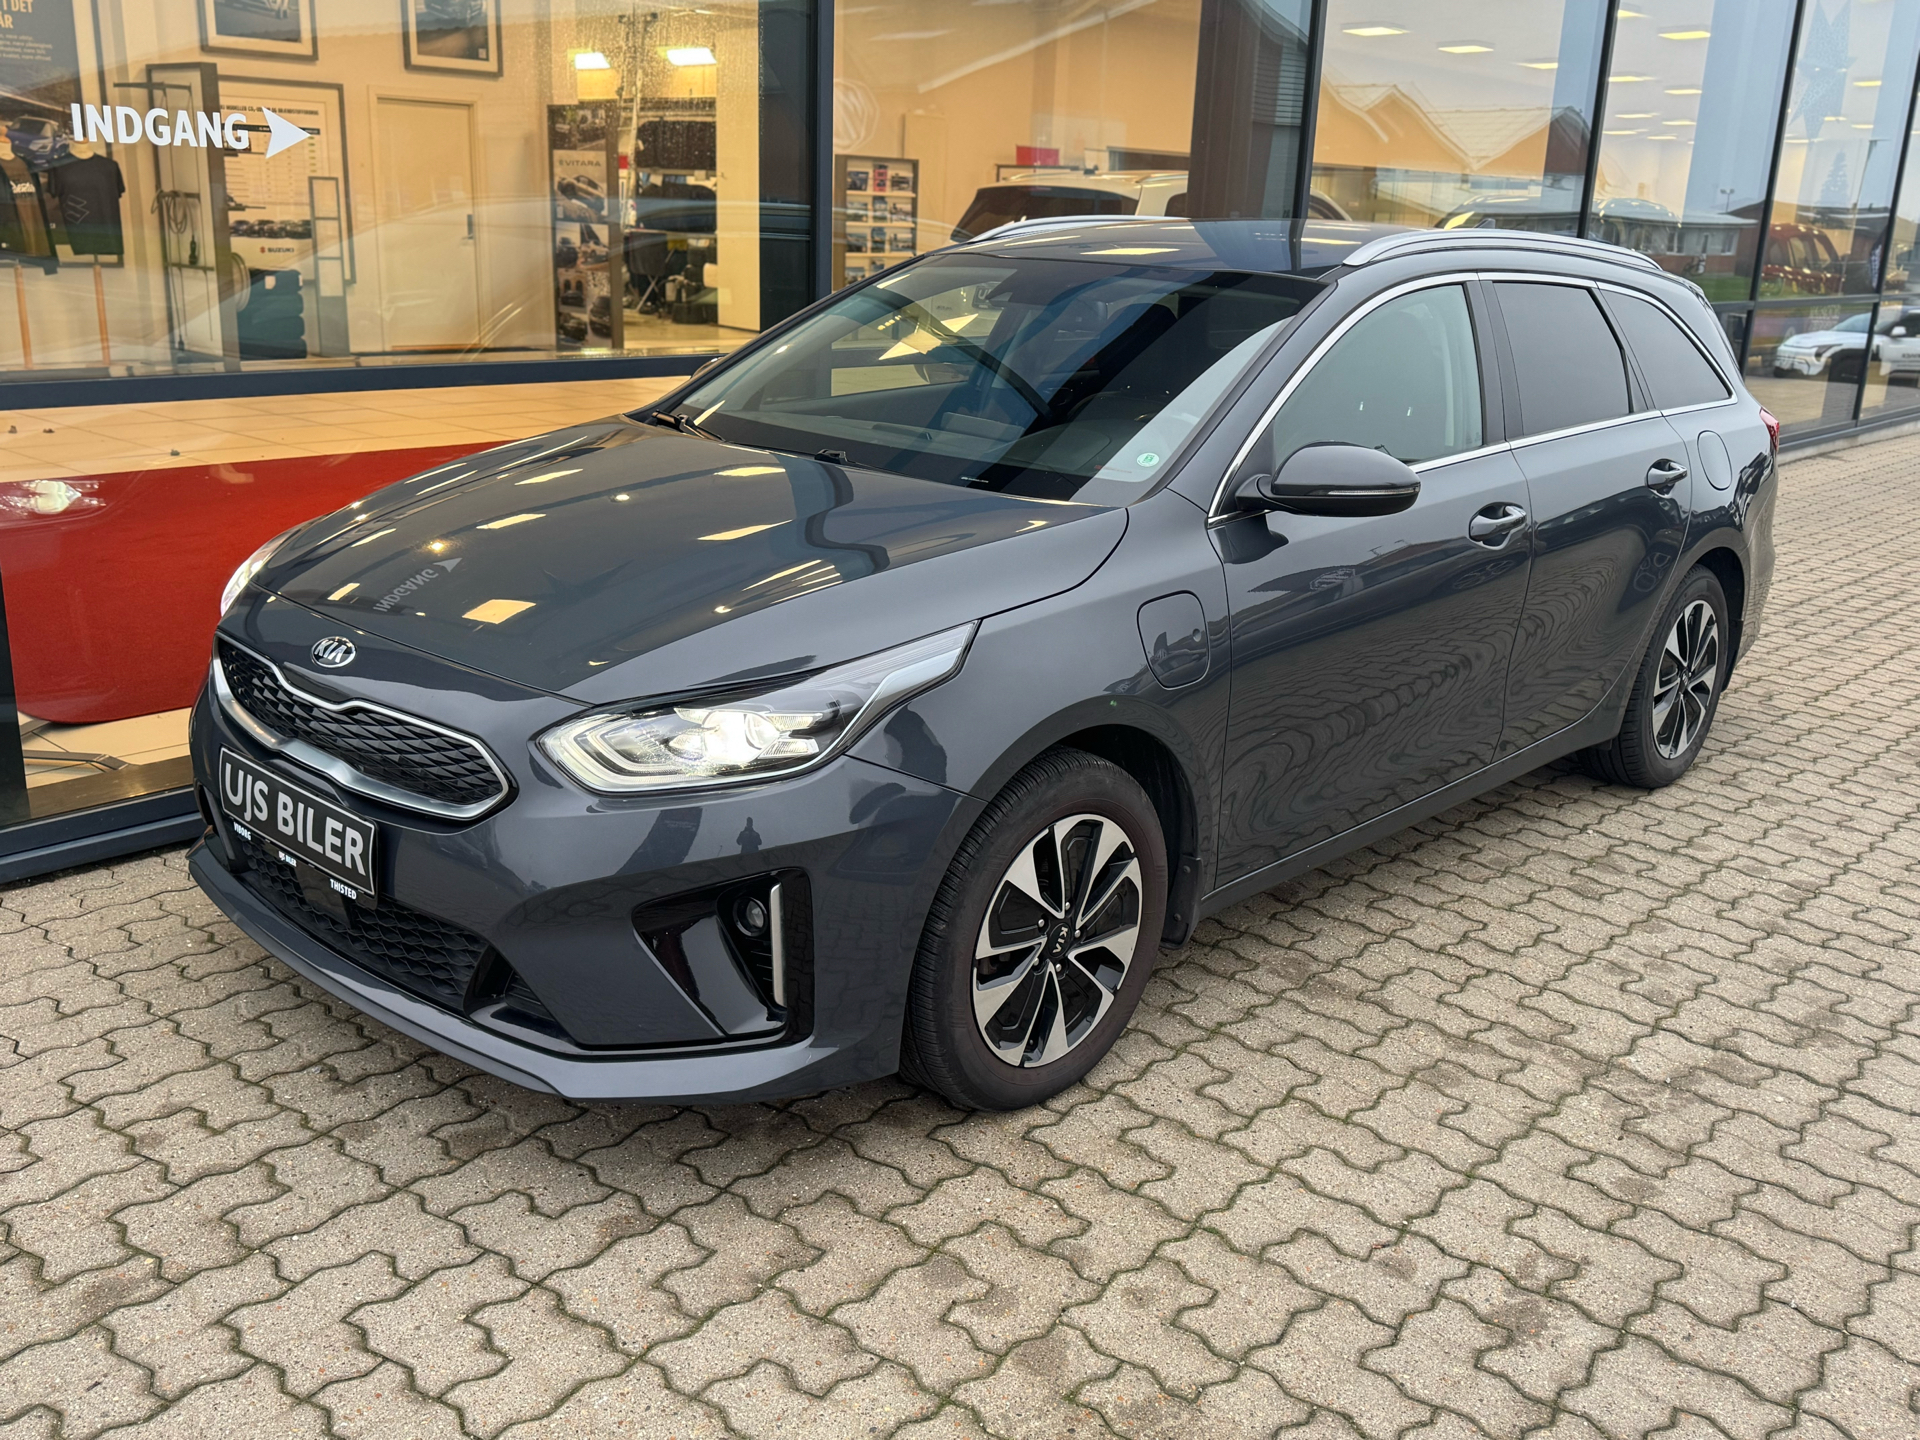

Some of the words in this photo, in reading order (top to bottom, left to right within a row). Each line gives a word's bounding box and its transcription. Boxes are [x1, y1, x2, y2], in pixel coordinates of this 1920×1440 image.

[70, 103, 250, 150] INDGANG
[314, 640, 347, 663] KIA
[225, 762, 269, 822] UJS
[277, 790, 366, 877] BILER
[233, 821, 252, 841] VIBORG
[329, 878, 357, 900] THISTED
[1052, 926, 1069, 954] KIA
